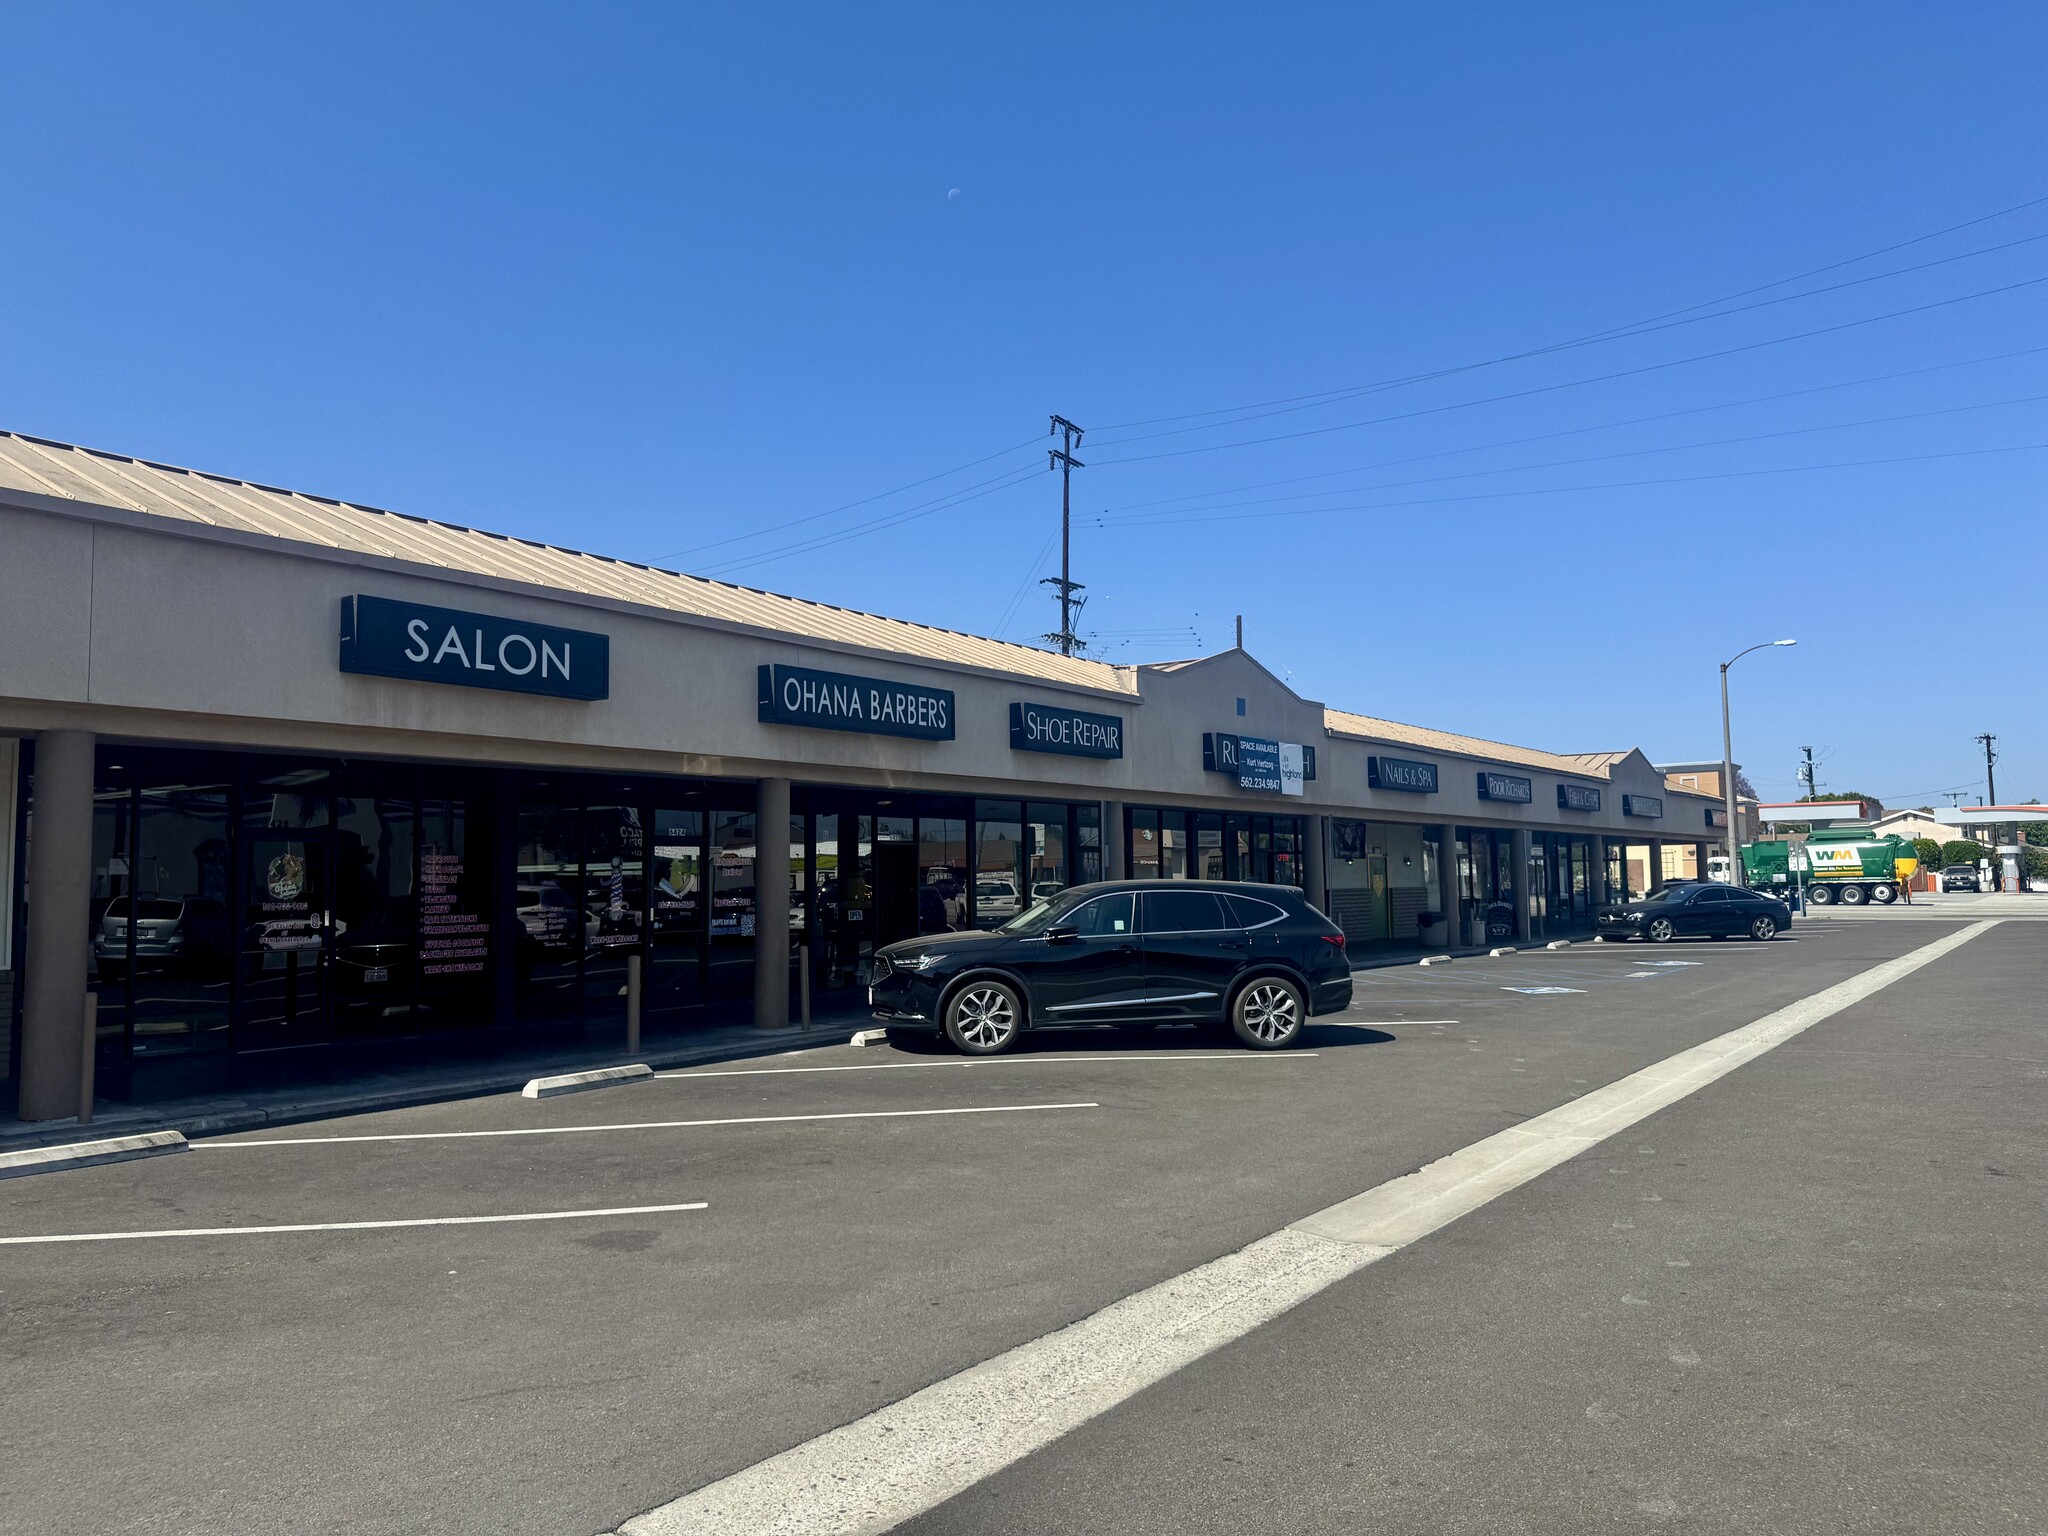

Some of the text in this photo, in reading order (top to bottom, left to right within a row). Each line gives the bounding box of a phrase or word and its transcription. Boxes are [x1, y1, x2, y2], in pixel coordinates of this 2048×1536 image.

[404, 619, 571, 682] SALON
[784, 677, 947, 729] OHANA BARBERS
[1027, 711, 1120, 750] SHOE REPAIR
[1240, 741, 1278, 754] SPACE AVAILABLE
[1247, 758, 1257, 767] Kurt
[1257, 759, 1274, 771] Hertzog
[1240, 776, 1280, 790] 562.234.9847
[1385, 763, 1432, 787] NAILS & SPA
[1489, 777, 1529, 799] POOR RICHARD'S
[1569, 789, 1579, 805] FISH
[1585, 791, 1599, 807] CHIPS
[669, 828, 686, 836] 6424
[1816, 850, 1853, 861] WM
[850, 911, 861, 919] OPEN
